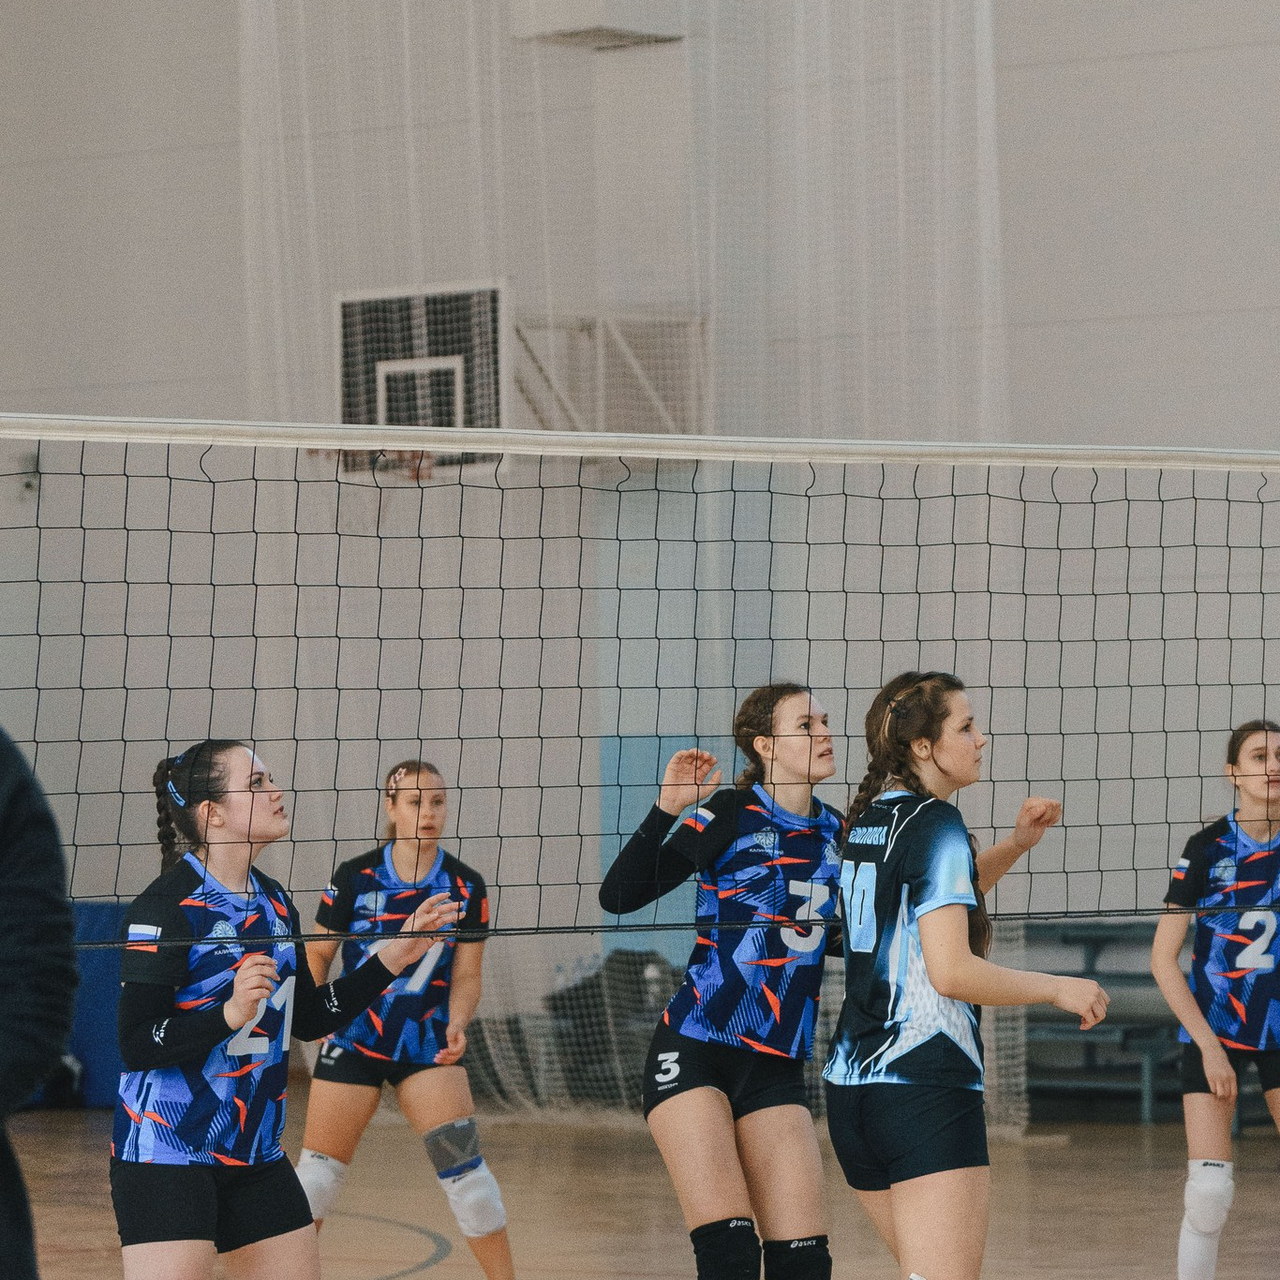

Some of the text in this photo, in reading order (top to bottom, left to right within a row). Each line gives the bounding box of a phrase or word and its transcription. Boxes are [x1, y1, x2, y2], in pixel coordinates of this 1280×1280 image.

[780, 879, 830, 953] 3
[1235, 909, 1278, 969] 2
[654, 1051, 680, 1083] 3
